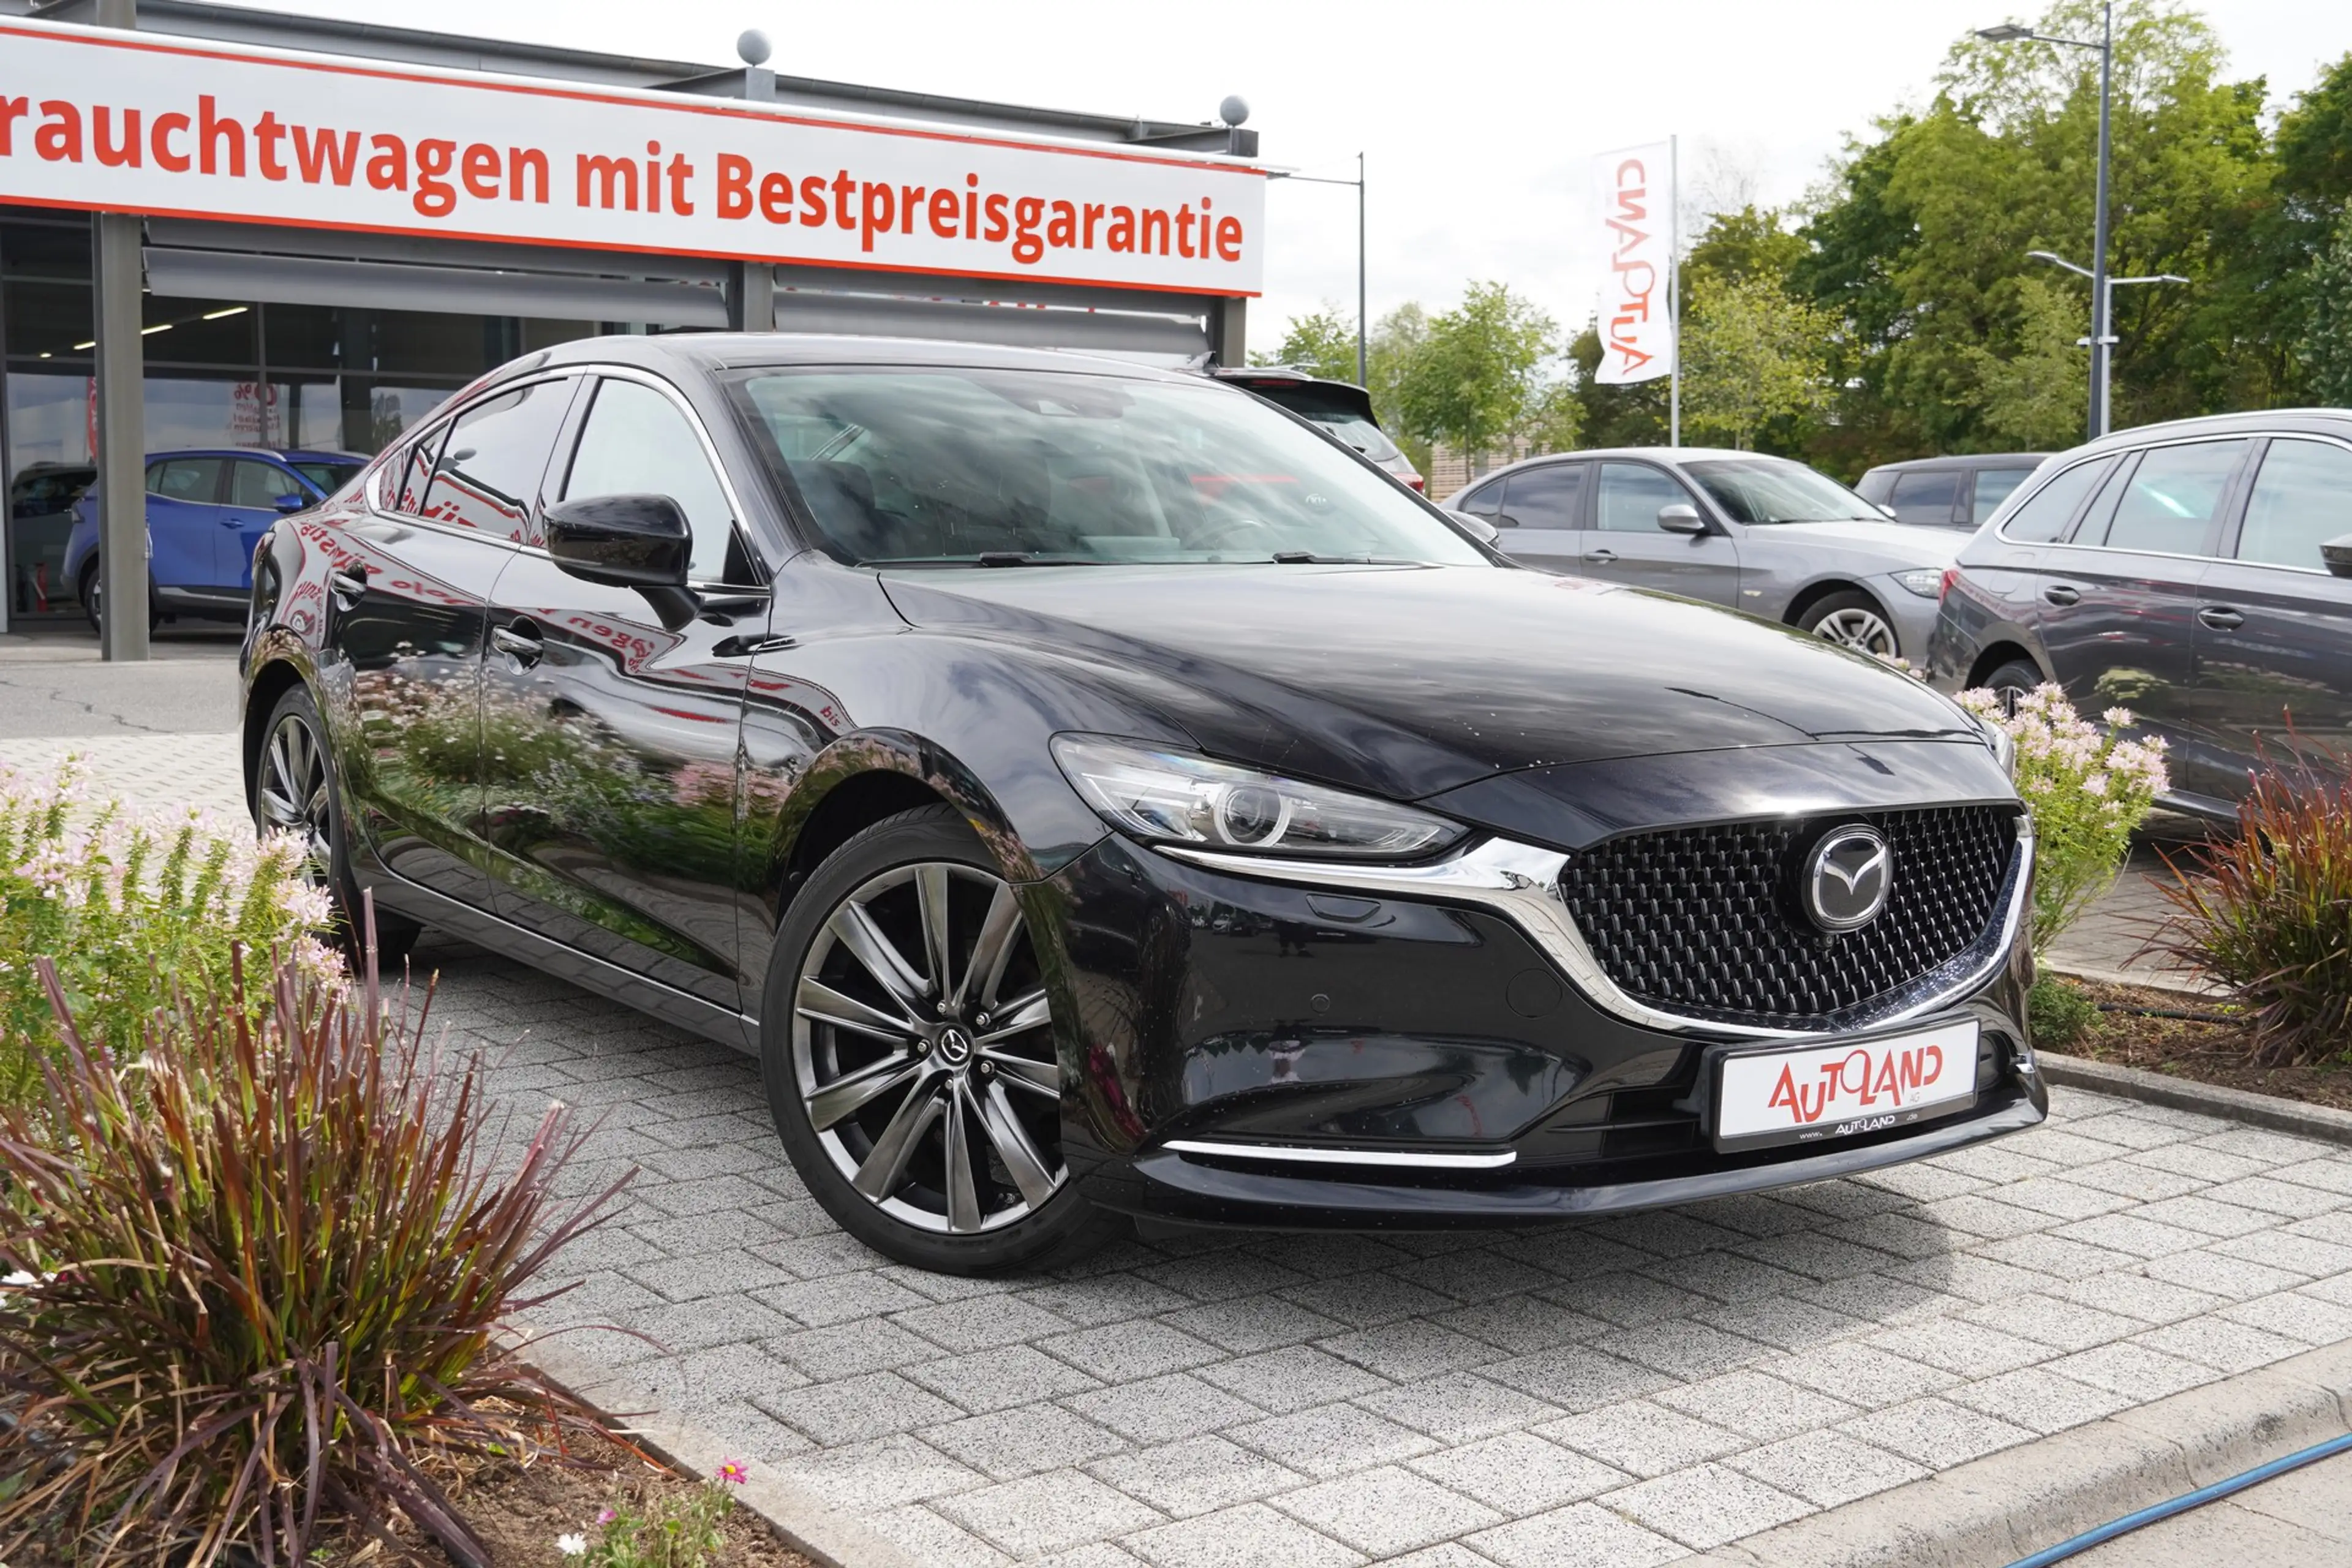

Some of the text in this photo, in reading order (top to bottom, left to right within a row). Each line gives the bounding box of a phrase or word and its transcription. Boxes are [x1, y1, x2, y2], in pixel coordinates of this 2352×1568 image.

[0, 95, 1243, 265] rauchtwagen mit Bestpreisgarantie
[1768, 1045, 1943, 1123] AUTOLAND
[1834, 1115, 1896, 1136] AUTOLAND
